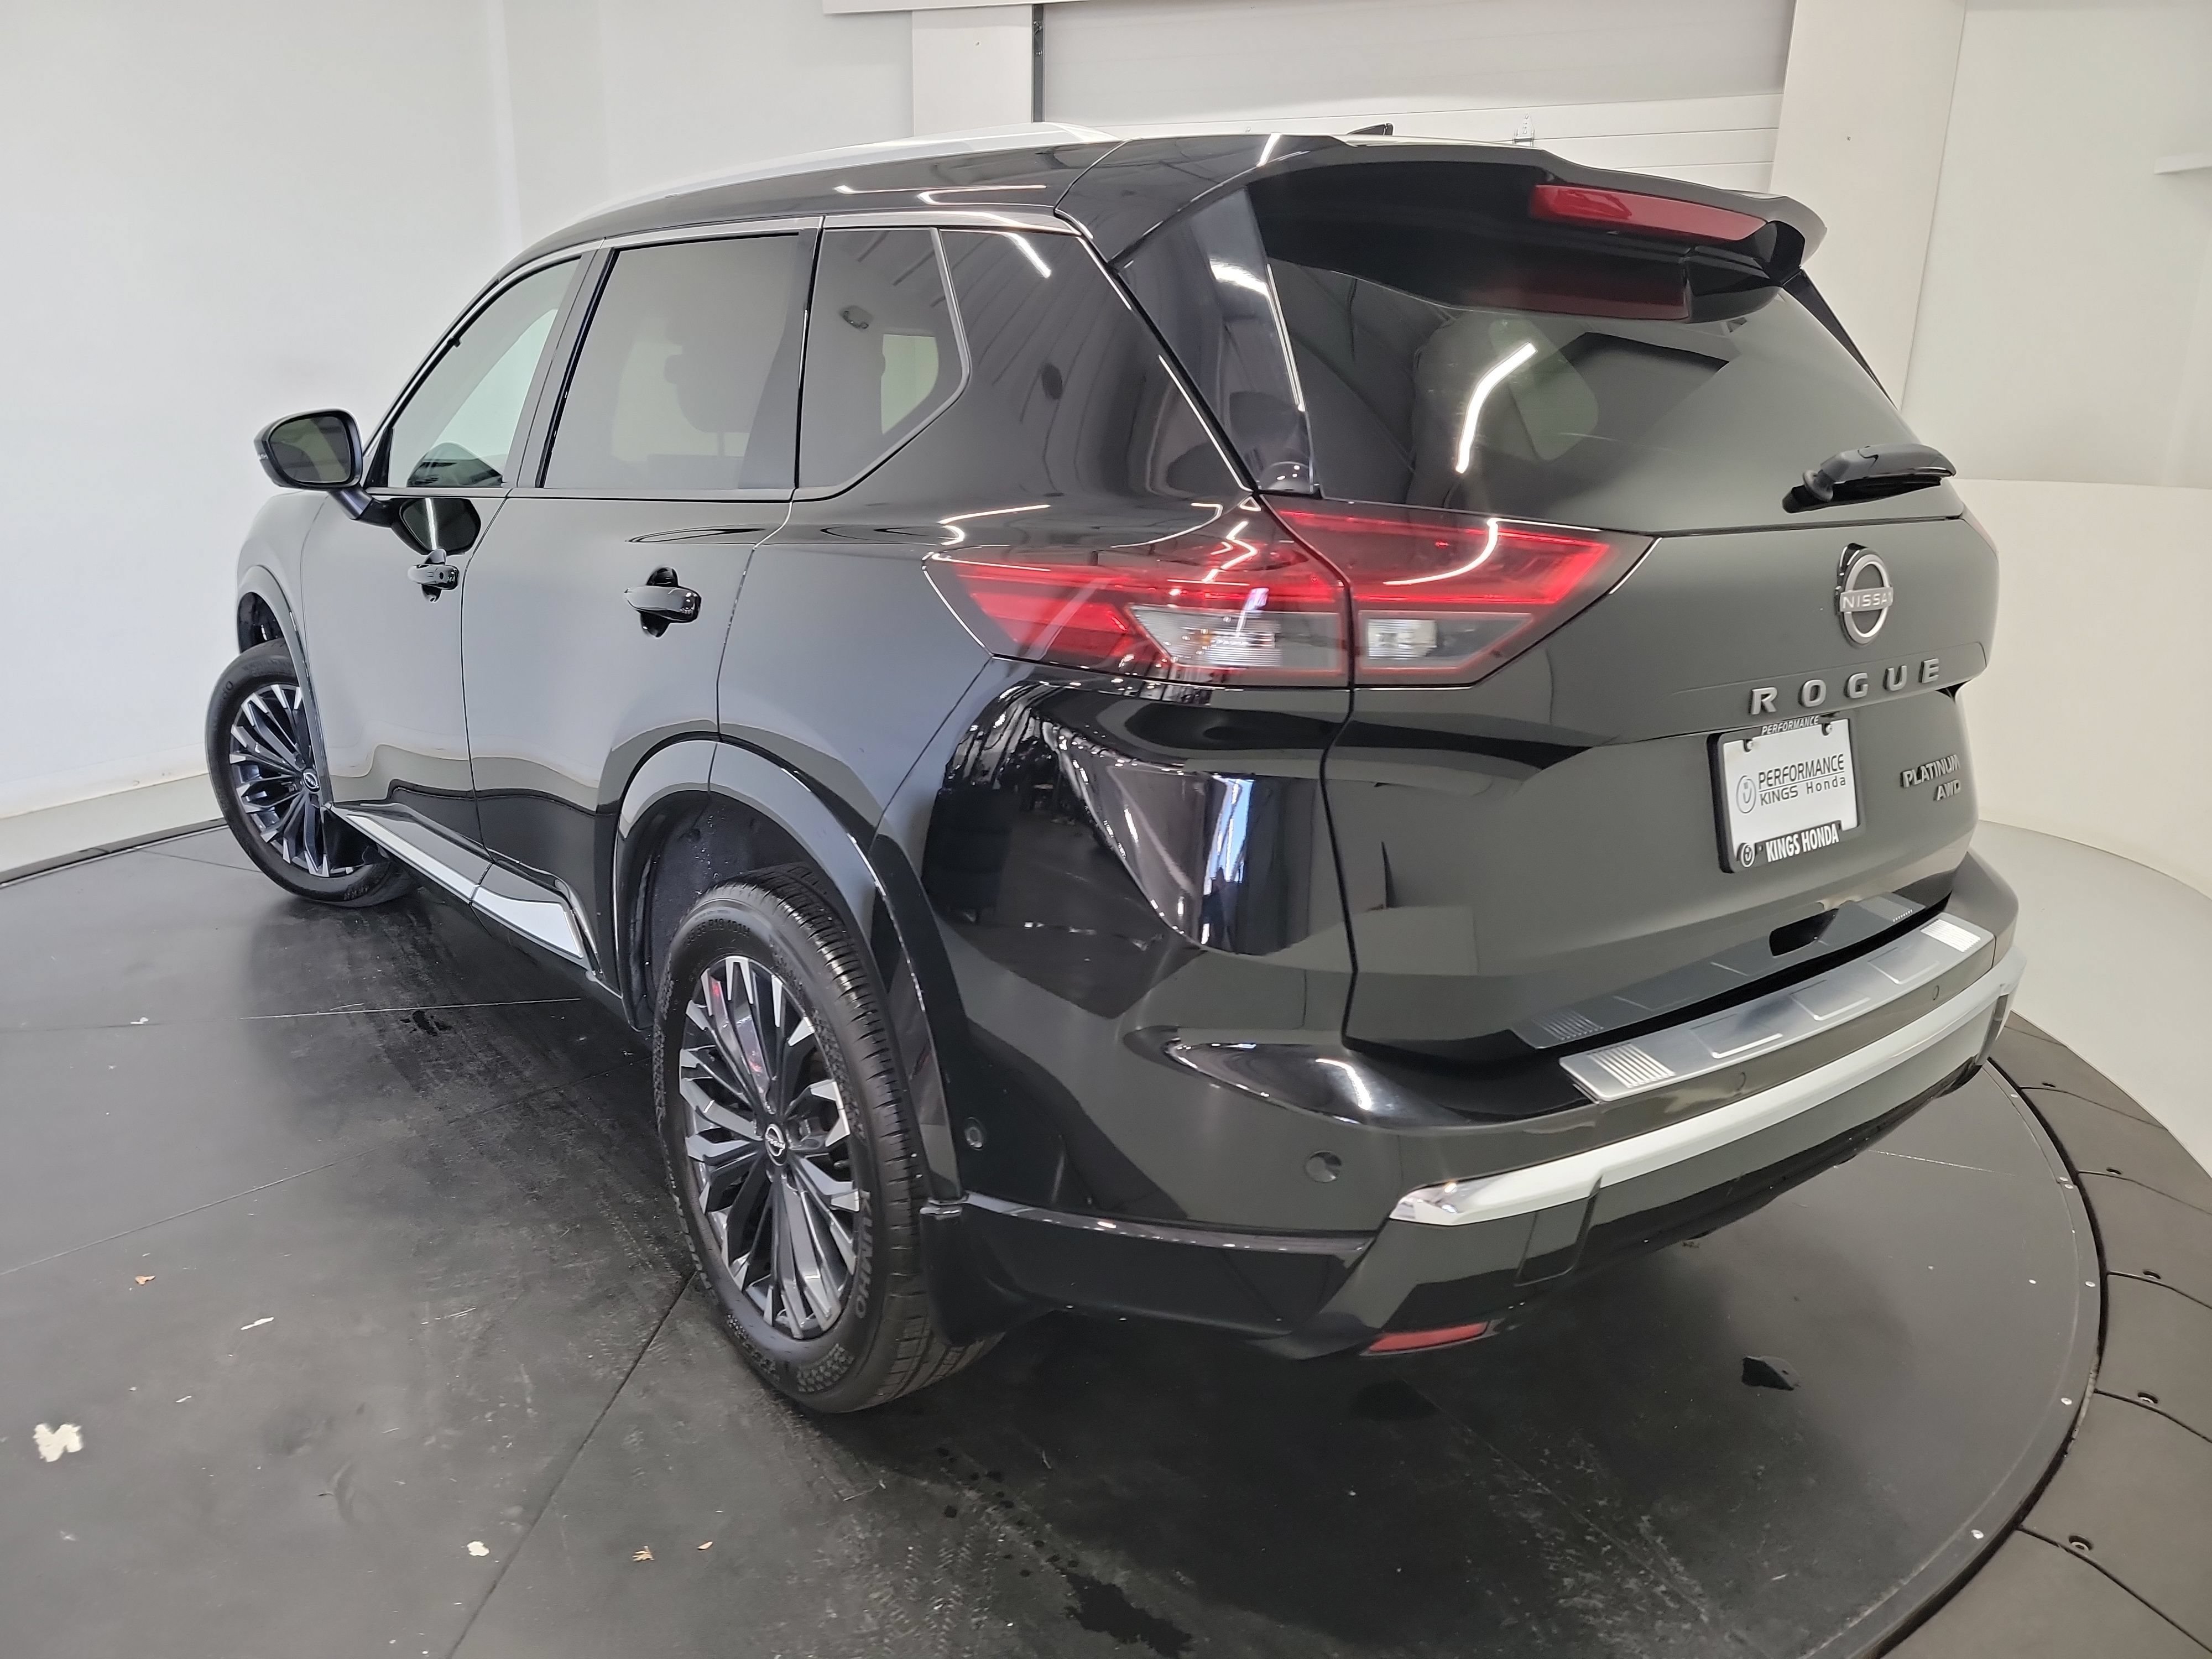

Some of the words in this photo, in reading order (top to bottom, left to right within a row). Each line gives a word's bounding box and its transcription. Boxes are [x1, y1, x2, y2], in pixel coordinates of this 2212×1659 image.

[1750, 658, 1939, 715] ROGUE
[1761, 716, 1819, 735] PERFORMANCE
[1758, 753, 1844, 790] PERFORMANCE
[1901, 754, 1960, 788] PLATINUM
[1760, 785, 1798, 806] KINGS
[1806, 776, 1846, 795] Honda
[1936, 779, 1961, 801] AWD
[1765, 833, 1801, 863] KINGS
[1801, 823, 1840, 852] HONDA
[855, 1189, 873, 1319] KUMHO
